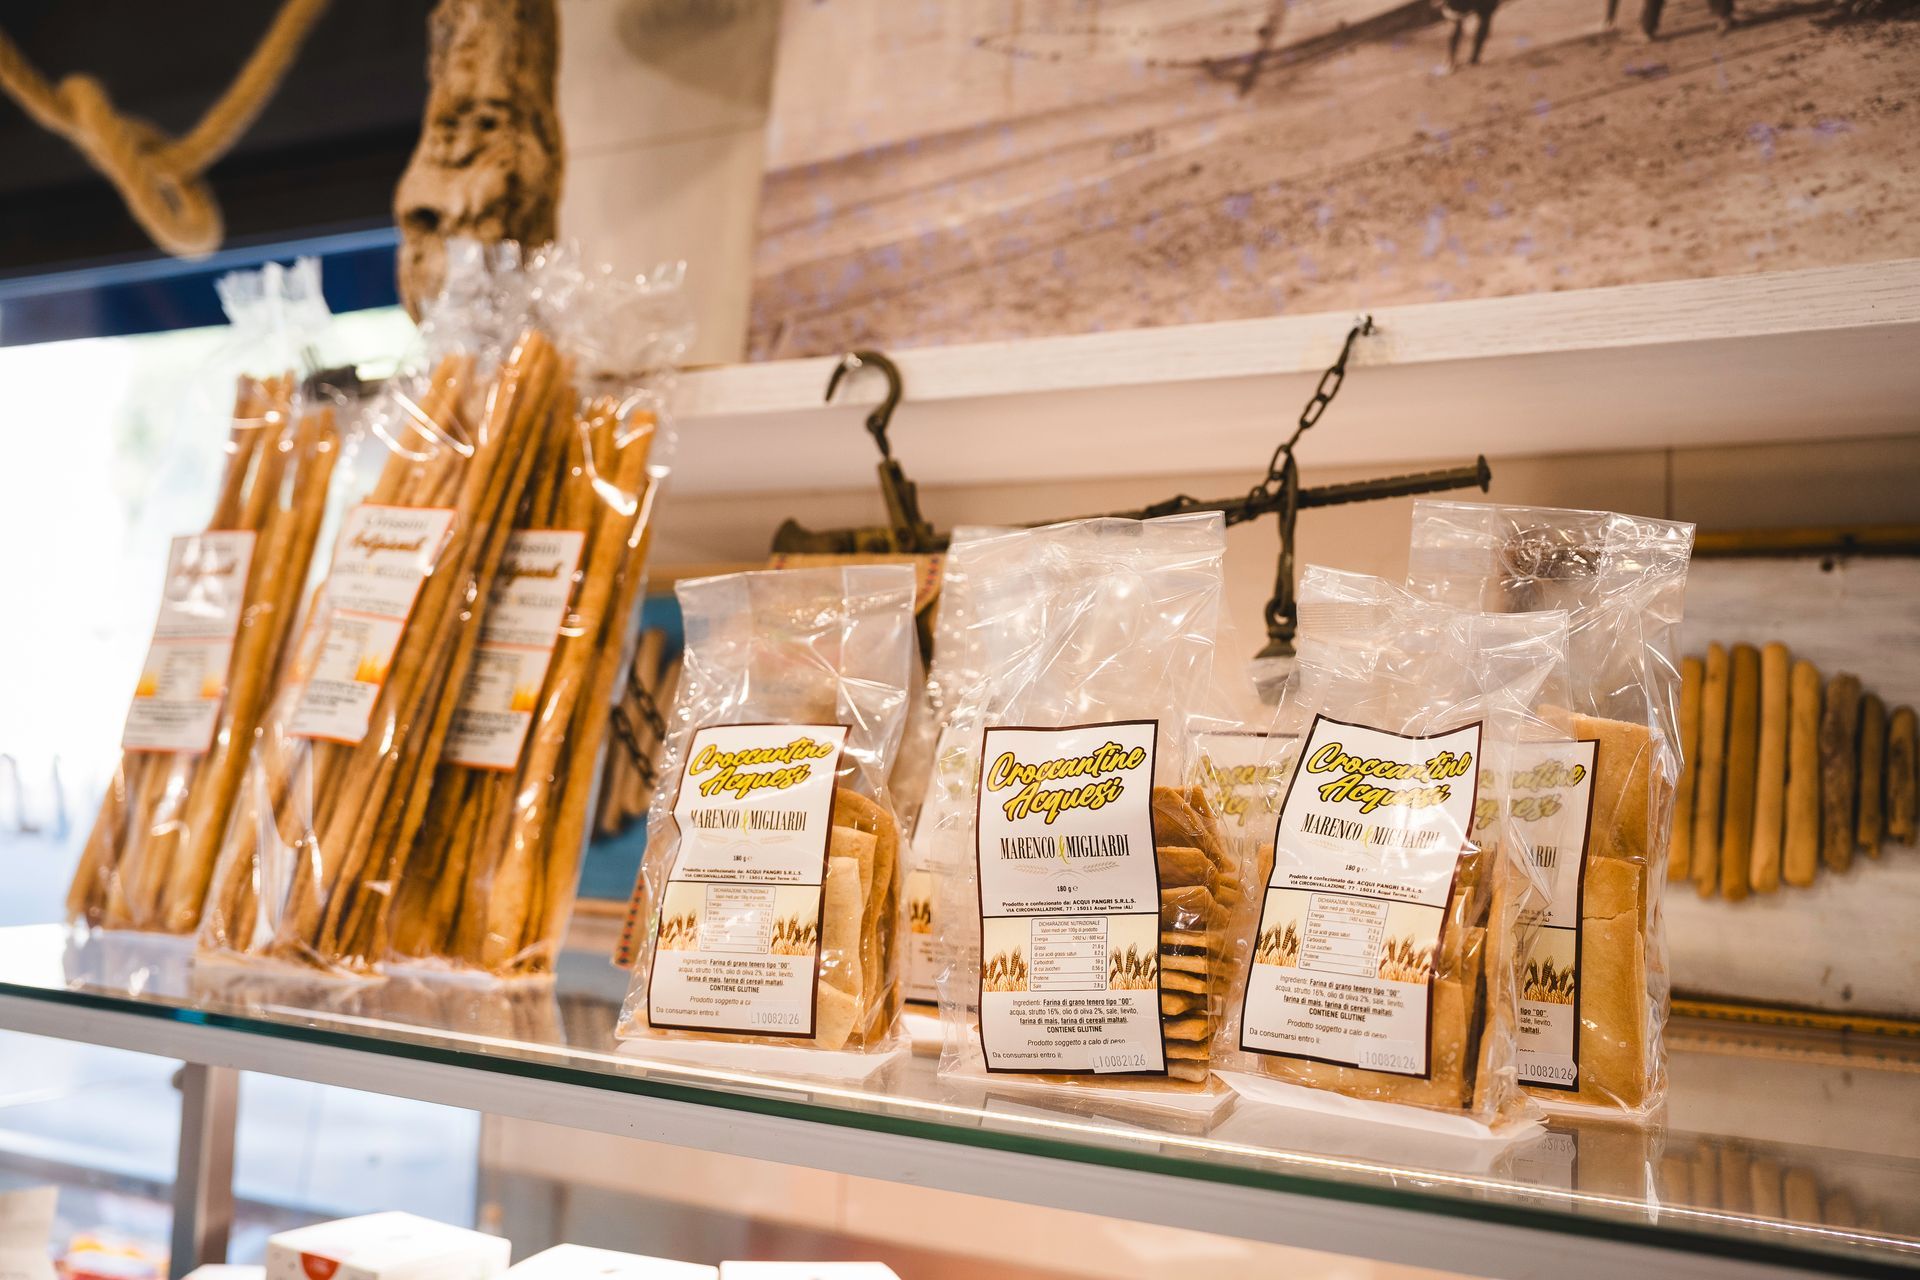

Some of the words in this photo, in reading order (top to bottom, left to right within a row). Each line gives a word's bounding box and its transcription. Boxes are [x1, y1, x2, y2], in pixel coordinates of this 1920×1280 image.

[689, 736, 834, 777] Croccantine
[987, 741, 1146, 792] Croccantine
[1306, 742, 1472, 782] Croccantine
[699, 763, 810, 800] Acquesi
[1002, 777, 1124, 824] Acquesi
[1319, 775, 1451, 814] Acquesi
[690, 809, 740, 831] MARENCO
[750, 810, 808, 832] MIGLIARDI
[1300, 813, 1362, 841] MARENCO
[1000, 836, 1056, 860] MARENCO
[1058, 834, 1069, 864] &
[1066, 834, 1130, 858] MIGLIARDI
[1314, 876, 1346, 884] confezionato
[1294, 987, 1311, 995] strutto
[1313, 989, 1326, 997] 16%,
[1310, 979, 1327, 987] Farina
[1353, 984, 1372, 993] tenero
[1284, 994, 1299, 1004] farina
[1308, 998, 1323, 1007] mais,
[1324, 1000, 1342, 1009] farina
[1350, 1004, 1370, 1013] cereali
[1372, 1007, 1393, 1017] maltati.
[1309, 1008, 1338, 1018] CONTIENE
[1340, 1012, 1366, 1022] GLUTINE
[1249, 1027, 1258, 1035] Da
[1260, 1030, 1296, 1040] consumarsi
[1287, 1019, 1314, 1029] Prodotto
[1315, 1024, 1342, 1033] soggetto
[1534, 1018, 1552, 1027] lievito,
[1518, 1063, 1574, 1080] L10082026
